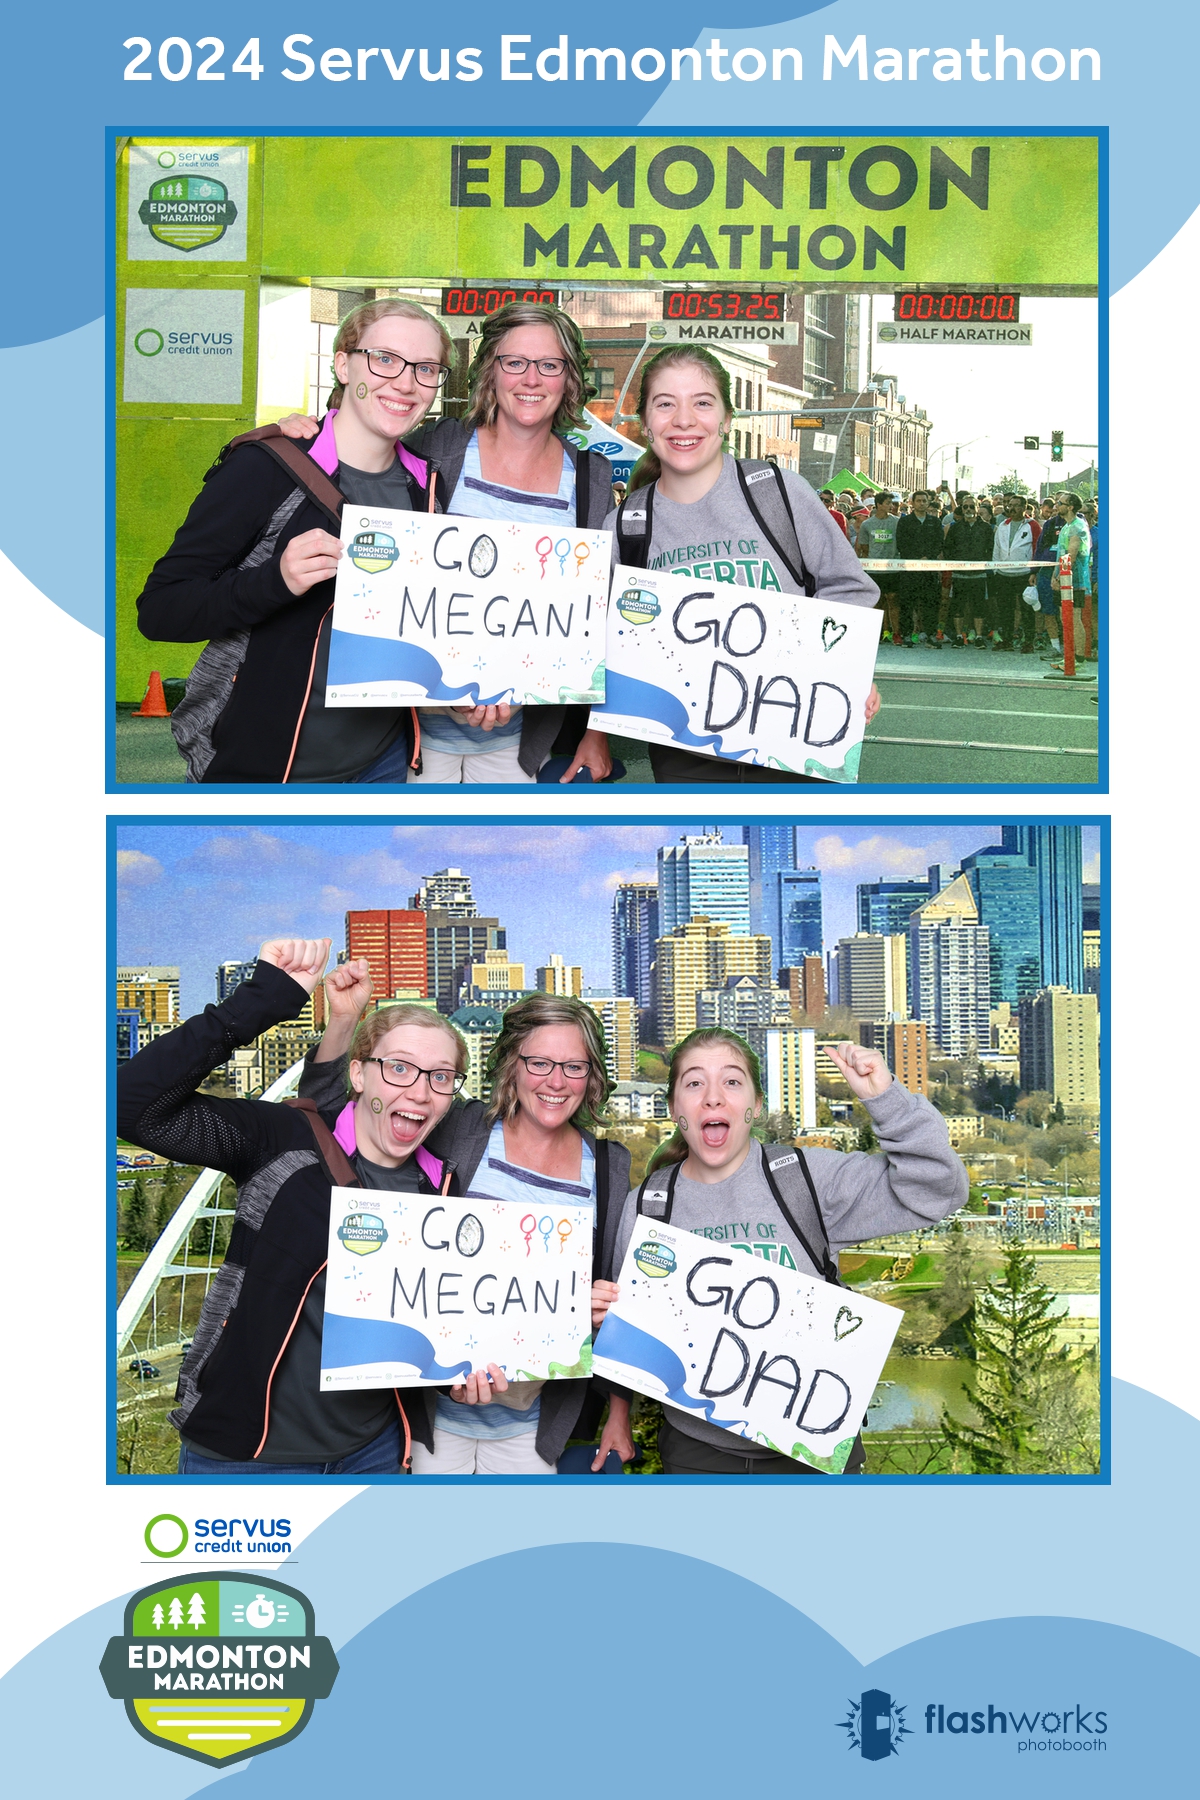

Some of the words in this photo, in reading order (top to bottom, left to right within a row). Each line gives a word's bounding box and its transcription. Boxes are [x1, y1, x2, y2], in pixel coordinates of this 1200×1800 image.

[178, 152, 220, 161] servus
[450, 144, 991, 211] EDMONTON
[149, 203, 227, 213] EDMONTON
[160, 214, 216, 222] MARATHON
[523, 223, 906, 271] MARATHON
[466, 321, 483, 334] A
[678, 325, 785, 340] MARATHON
[900, 328, 939, 340] HALF
[942, 328, 1031, 341] MARATHON
[168, 331, 233, 345] servus
[167, 345, 200, 354] credit
[203, 347, 233, 355] union
[750, 470, 771, 480] ROOTS
[370, 519, 393, 527] servus
[352, 545, 395, 555] EDMONTON
[433, 526, 498, 579] GO
[737, 539, 760, 555] OF
[398, 585, 592, 639] MEGAN!
[621, 599, 657, 611] EDMONTON
[625, 605, 652, 614] MARATHON
[672, 591, 767, 658] GO
[704, 659, 852, 748] DAD
[774, 1155, 795, 1167] ROOTS
[342, 1227, 384, 1236] EDMONTON
[420, 1206, 485, 1258] GO
[756, 1221, 777, 1239] OF
[638, 1249, 674, 1267] EDMONTON
[641, 1257, 668, 1269] MARATHON
[390, 1266, 577, 1320] MEGAN!
[686, 1256, 780, 1330] GO
[700, 1326, 852, 1435] DAD
